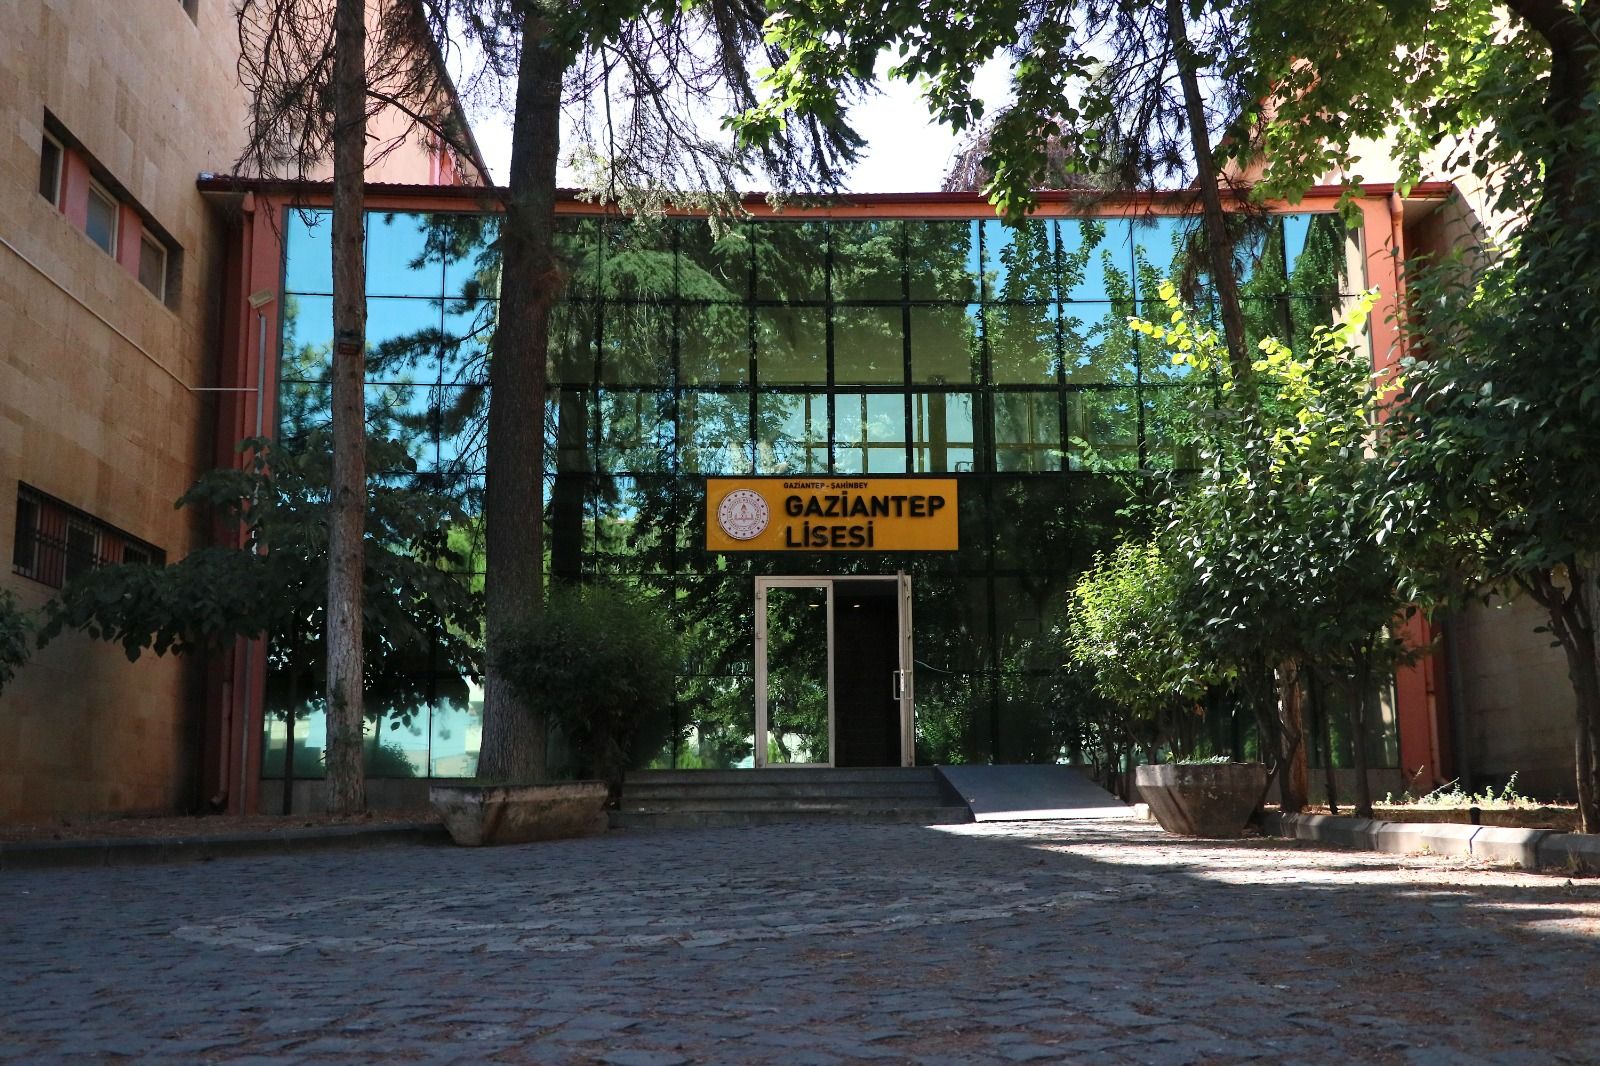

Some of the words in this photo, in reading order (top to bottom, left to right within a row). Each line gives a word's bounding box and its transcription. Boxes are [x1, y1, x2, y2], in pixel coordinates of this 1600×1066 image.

[783, 481, 825, 489] GAZİANTEP
[830, 481, 868, 490] ŞAHİNBEY
[785, 490, 946, 518] GAZİANTEP
[785, 520, 874, 548] LİSESİ
